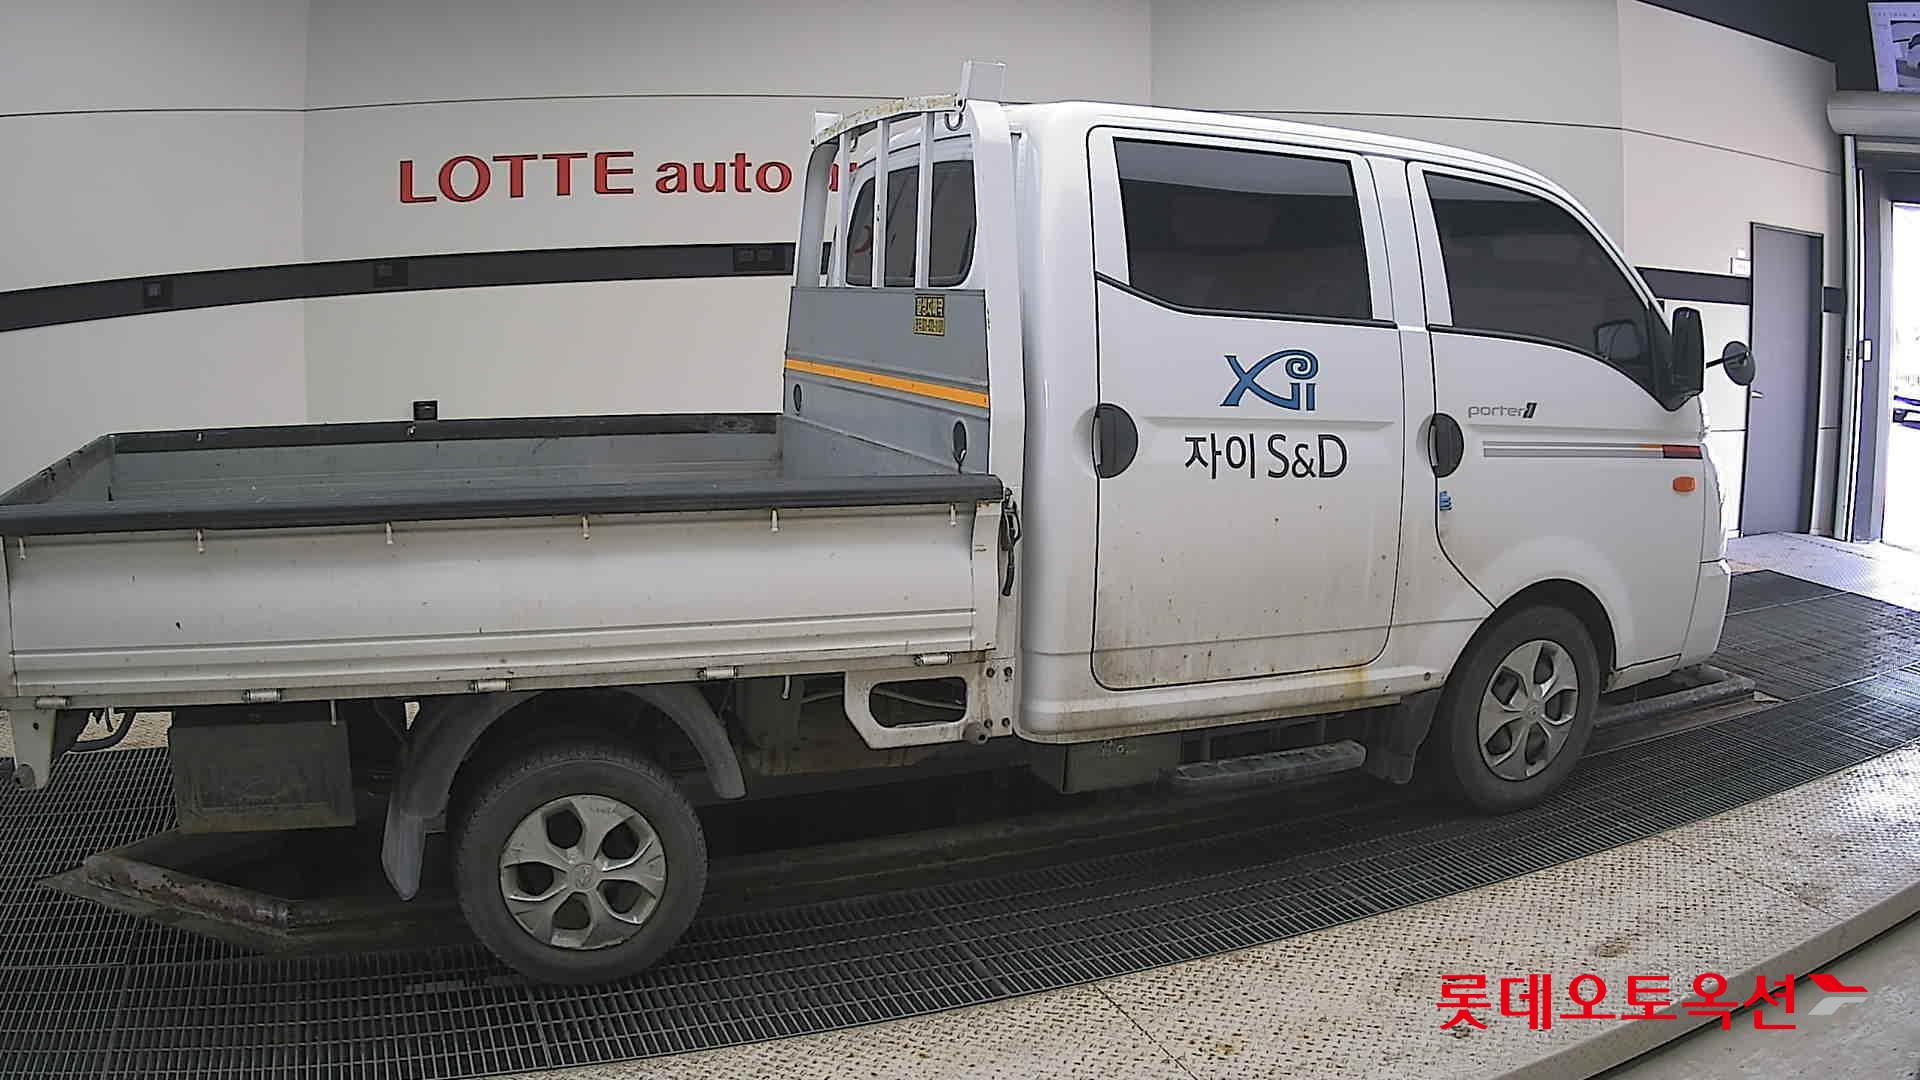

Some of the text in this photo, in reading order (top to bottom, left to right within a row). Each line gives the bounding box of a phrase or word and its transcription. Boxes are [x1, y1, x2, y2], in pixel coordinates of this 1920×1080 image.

[400, 151, 635, 204] LOTTE
[655, 152, 793, 194] auto
[1468, 405, 1524, 418] porter
[1185, 433, 1348, 480] 자이 S&D
